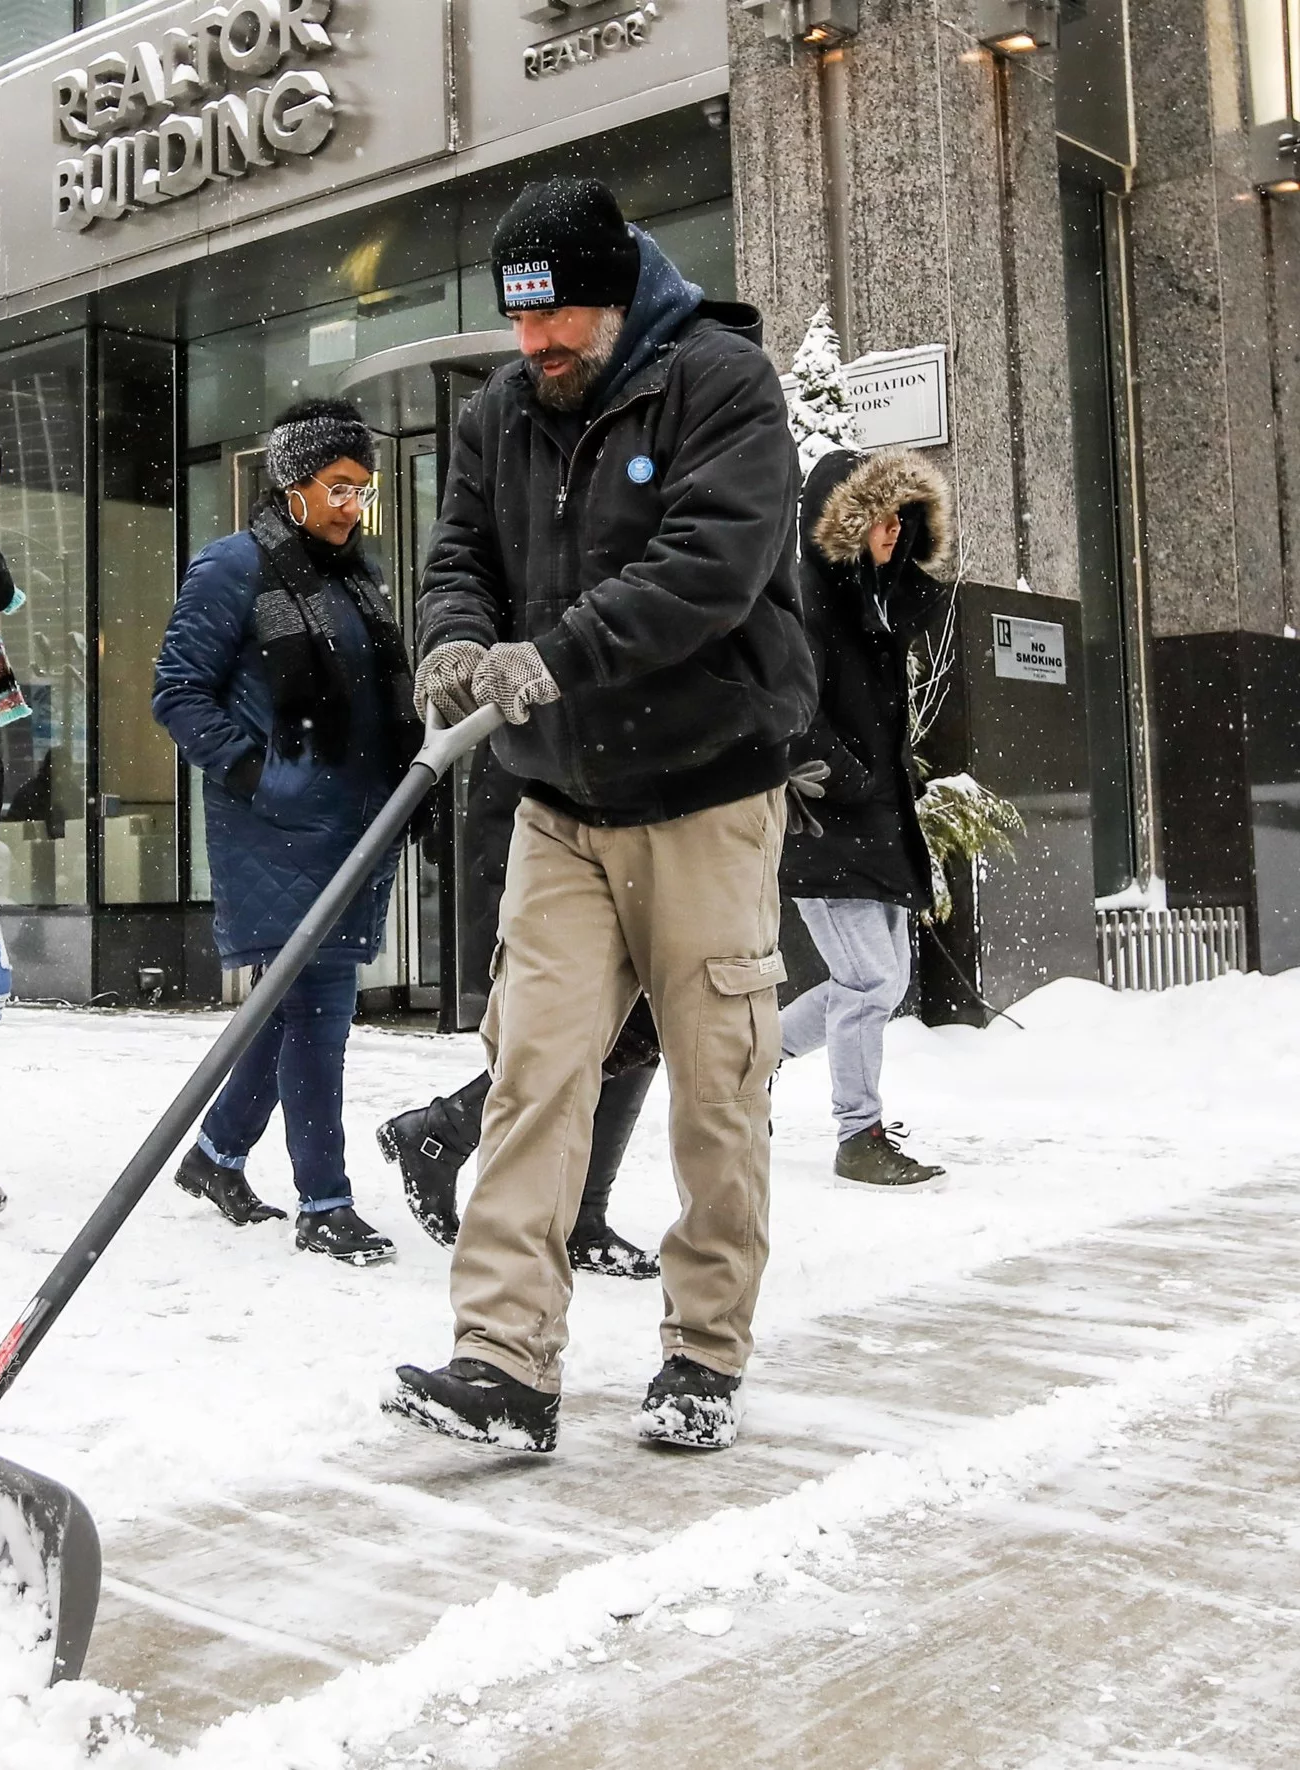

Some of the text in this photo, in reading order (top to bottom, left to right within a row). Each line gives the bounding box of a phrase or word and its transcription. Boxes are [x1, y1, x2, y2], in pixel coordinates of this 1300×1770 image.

[52, 0, 333, 147] REALTOR
[53, 70, 334, 233] BUILDING
[502, 260, 549, 275] CHICAGO
[1031, 642, 1046, 653] NO
[1016, 652, 1062, 667] SMOKING
